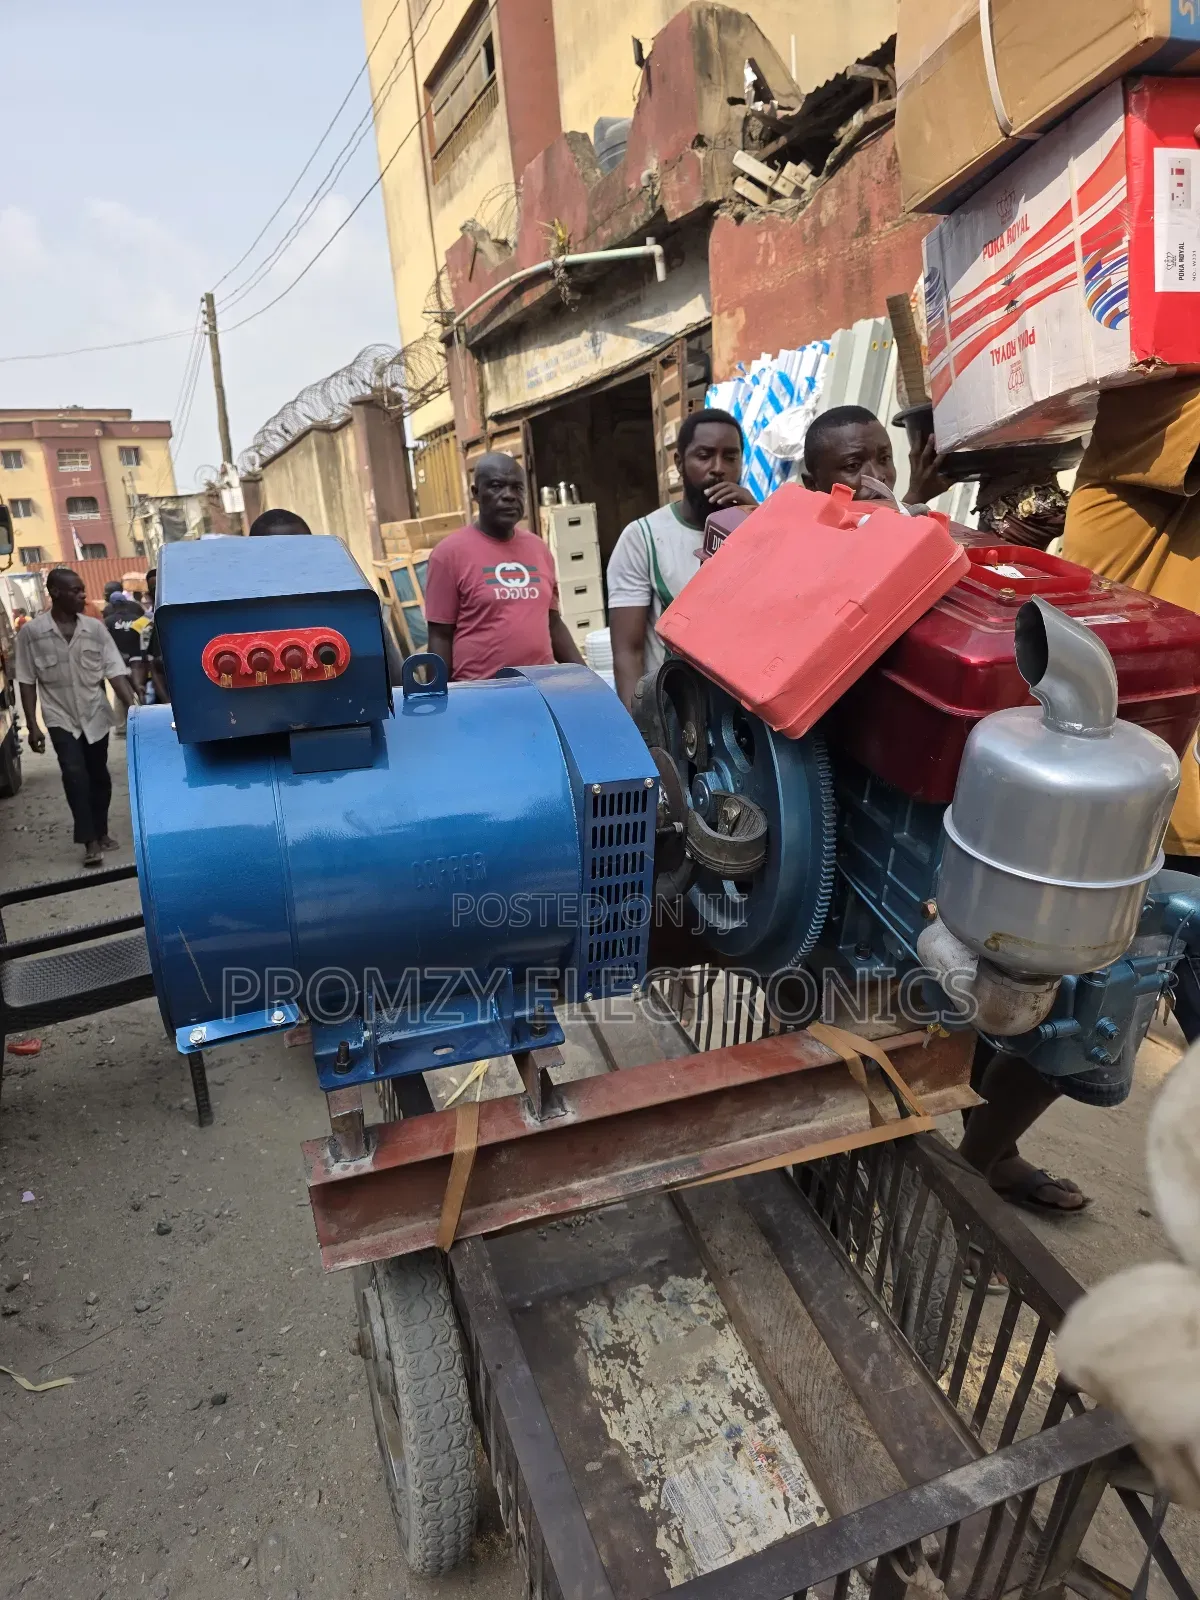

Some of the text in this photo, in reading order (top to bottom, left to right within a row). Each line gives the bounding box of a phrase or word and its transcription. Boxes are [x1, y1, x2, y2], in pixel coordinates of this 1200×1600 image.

[983, 213, 1030, 262] POKA ROYAL
[990, 339, 1017, 367] ROYAL
